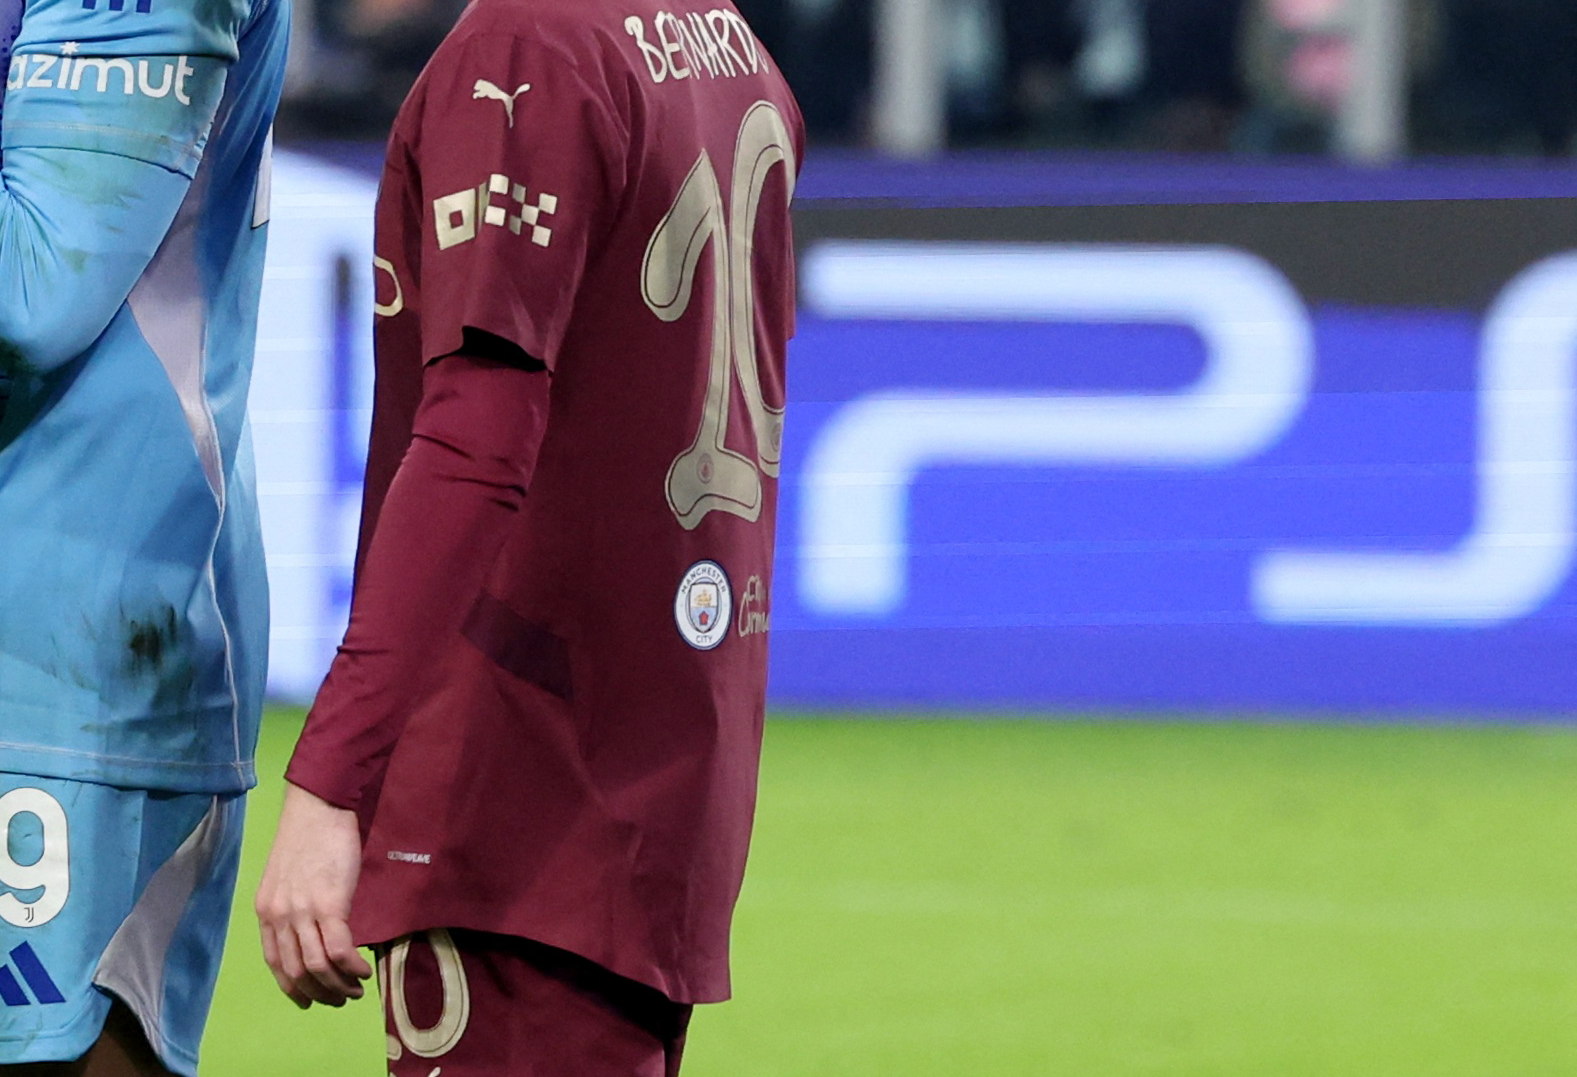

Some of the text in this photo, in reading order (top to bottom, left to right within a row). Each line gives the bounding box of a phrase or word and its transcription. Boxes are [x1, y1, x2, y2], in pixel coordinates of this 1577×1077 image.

[6, 41, 194, 106] azimut
[624, 9, 769, 83] BERNARD
[641, 100, 795, 529] 10
[681, 566, 727, 594] MANCHESTER
[696, 635, 713, 644] CITY
[378, 928, 470, 1058] 0
